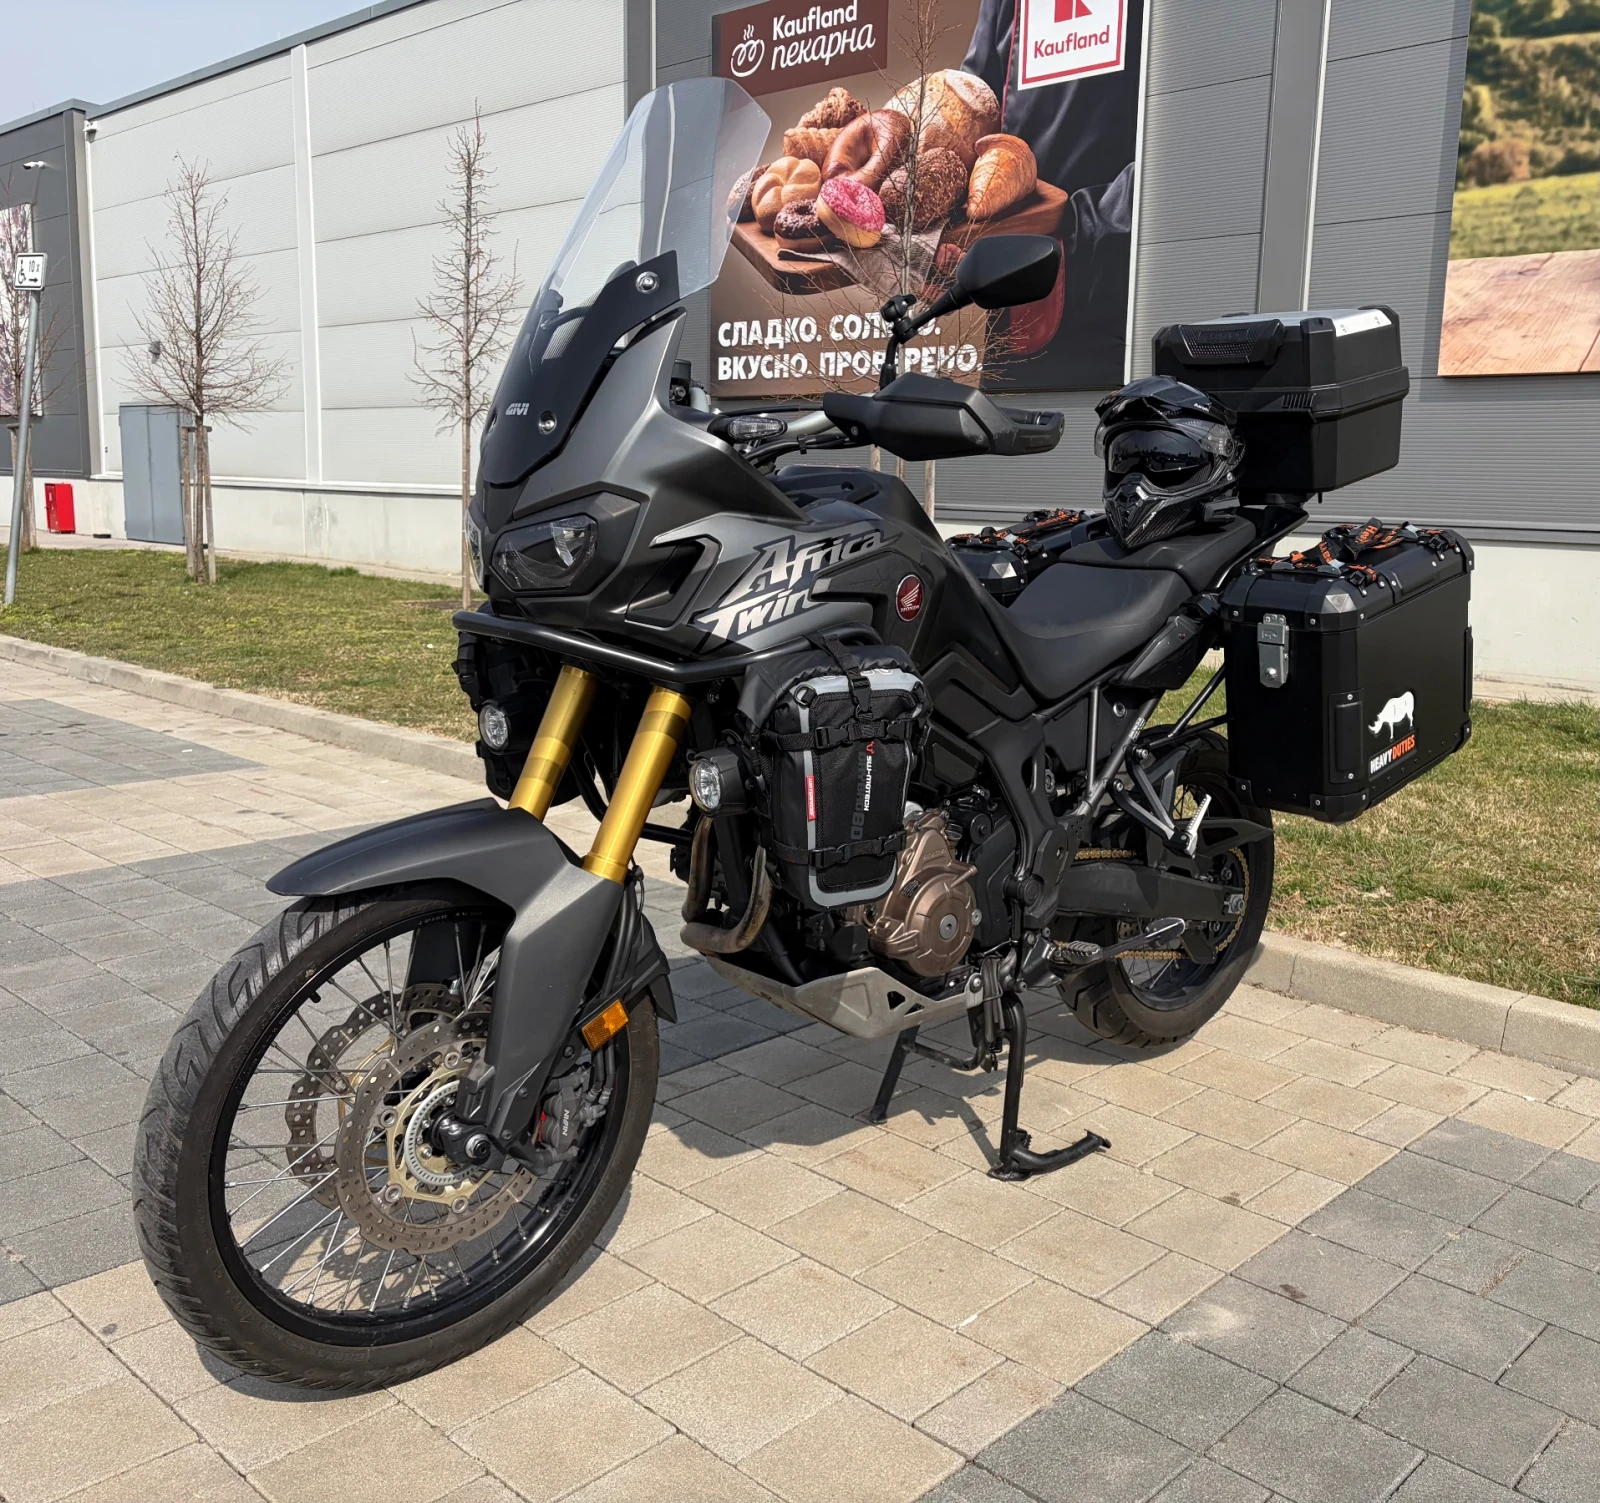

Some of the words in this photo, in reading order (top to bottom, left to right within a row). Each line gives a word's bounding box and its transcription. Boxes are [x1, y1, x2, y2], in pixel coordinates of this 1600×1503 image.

[773, 0, 858, 40] Kaufland
[771, 24, 876, 70] пекарна
[1034, 25, 1110, 58] Kaufland
[29, 260, 36, 272] 10
[718, 318, 822, 349] СЛАДКО.
[718, 354, 812, 380] ВКУСНО.
[505, 403, 530, 415] GIVI
[718, 530, 886, 607] Africa
[697, 587, 822, 640] Twin
[900, 605, 920, 613] HONDA
[863, 755, 872, 812] SW-MOTECH
